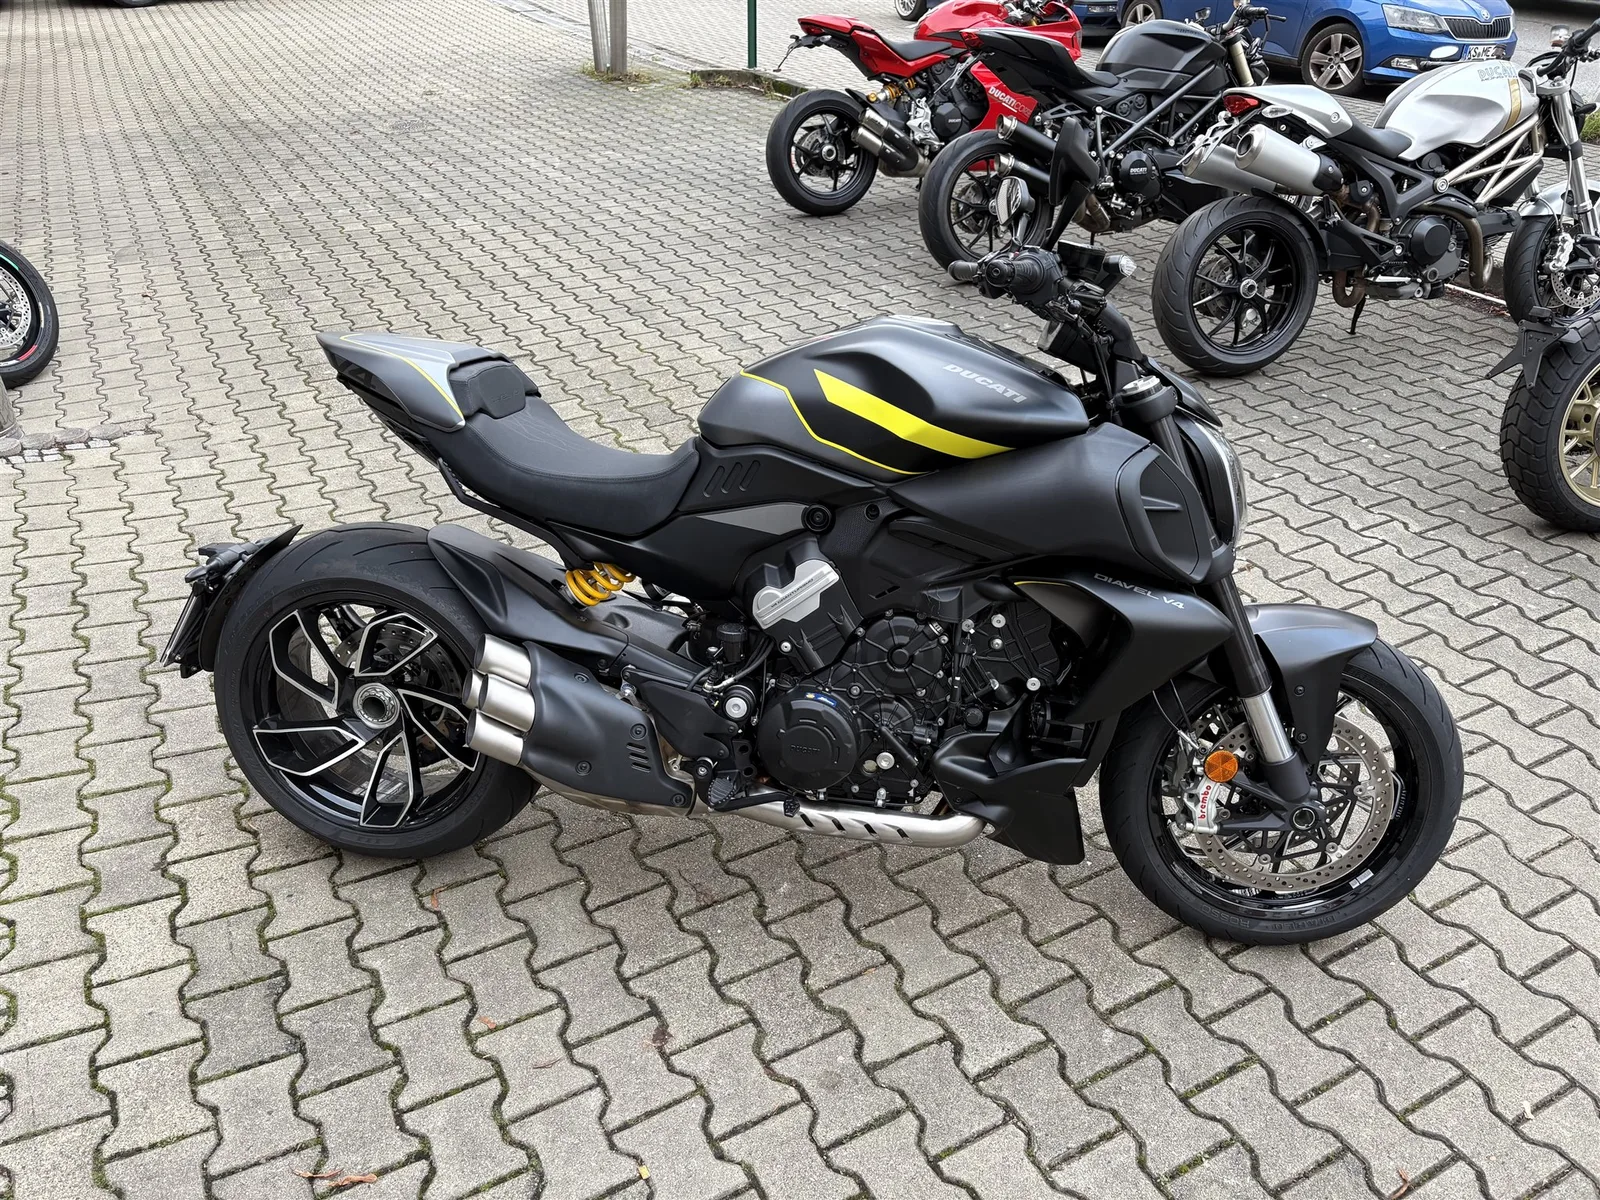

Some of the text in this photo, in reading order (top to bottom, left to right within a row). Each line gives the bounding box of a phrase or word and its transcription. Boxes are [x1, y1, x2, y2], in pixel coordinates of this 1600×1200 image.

[943, 363, 1027, 404] DUCATI
[1093, 572, 1185, 609] DIAVEL V4
[1198, 785, 1212, 820] brembo
[1201, 903, 1250, 927] ROSSO
